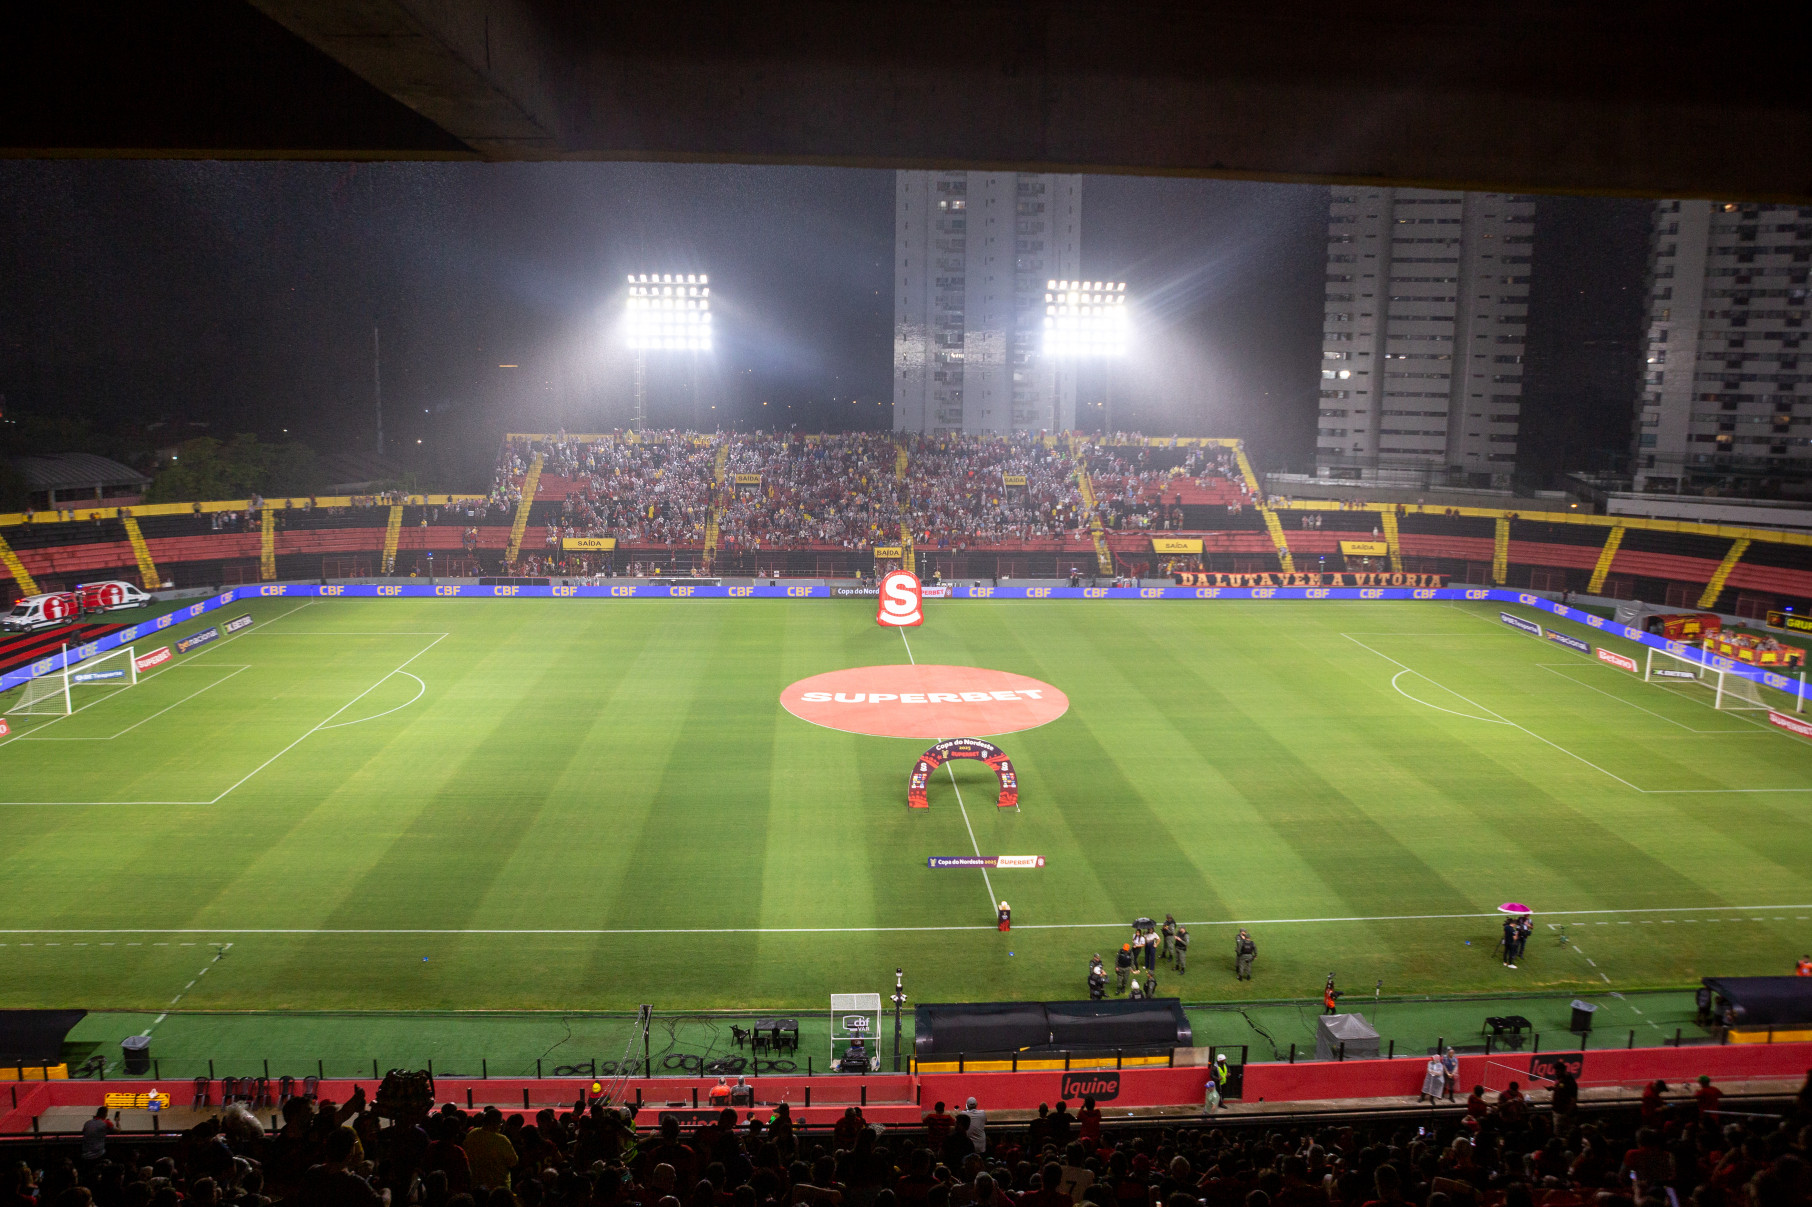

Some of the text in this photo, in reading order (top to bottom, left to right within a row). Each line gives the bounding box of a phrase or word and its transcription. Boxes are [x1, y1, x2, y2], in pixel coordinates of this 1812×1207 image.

[1181, 573, 1208, 586] DA
[1215, 574, 1274, 587] LUTA
[1277, 574, 1322, 586] VEM
[1332, 574, 1344, 586] A
[260, 586, 286, 596] CBF
[320, 586, 344, 596] CBF
[377, 586, 402, 596] CBF
[436, 586, 460, 596] CBF
[494, 586, 519, 596] CBF
[552, 586, 577, 596] CBF
[611, 586, 636, 596] CBF
[670, 586, 694, 596] CBF
[728, 586, 754, 596] CBF
[787, 586, 812, 596] CBF
[969, 588, 994, 598] CBF
[1026, 588, 1051, 598] CBF
[1084, 588, 1108, 598] CBF
[1140, 588, 1164, 598] CBF
[1196, 589, 1220, 598] CBF
[1251, 589, 1276, 598] CBF
[1306, 589, 1330, 598] CBF
[1360, 589, 1384, 598] CBF
[1413, 589, 1437, 599] CBF
[1466, 590, 1489, 600] CBF
[220, 590, 234, 604] CBF
[1520, 594, 1538, 605] CBF
[190, 602, 205, 616] CBF
[1554, 603, 1568, 616] CBF
[157, 614, 173, 629] CBF
[1587, 614, 1604, 628] CBF
[120, 626, 138, 642] CBF
[1624, 627, 1644, 640] CBF
[79, 642, 98, 658] CBF
[1665, 640, 1687, 655] CBF
[137, 648, 171, 668] SUPERBET
[1599, 651, 1632, 669] Betano
[1712, 656, 1735, 670] CBF
[32, 658, 53, 676] CBF
[1764, 672, 1790, 688] CBF
[801, 689, 1042, 704] SUPERBET
[936, 742, 953, 751] Copa
[964, 739, 994, 751] Nordeste
[854, 1018, 870, 1027] cbf
[1064, 1078, 1118, 1098] Iquine
